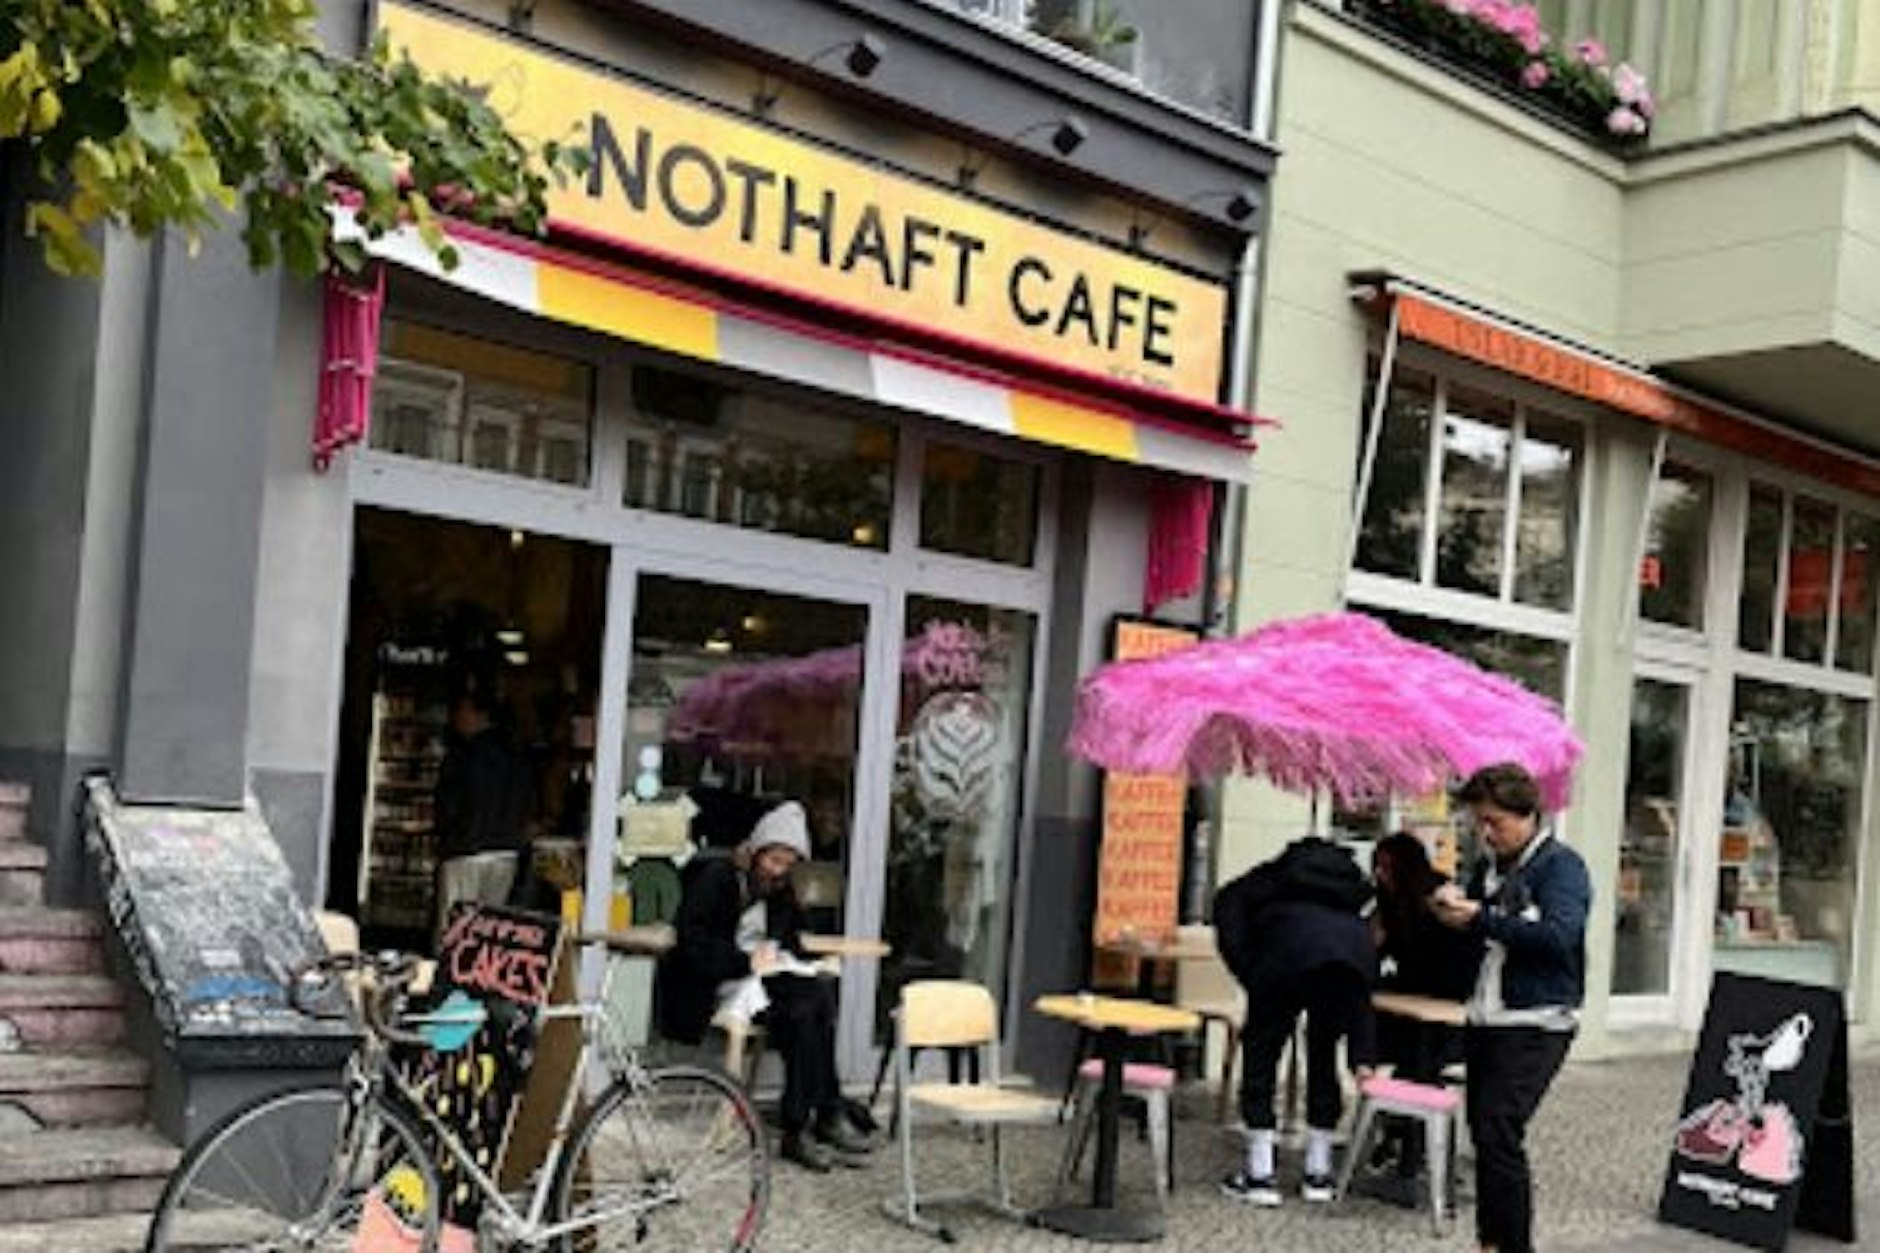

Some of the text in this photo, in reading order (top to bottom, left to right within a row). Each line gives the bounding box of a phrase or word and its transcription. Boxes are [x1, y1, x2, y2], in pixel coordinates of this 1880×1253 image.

[586, 111, 1178, 367] NOTHAFT CAFE
[450, 940, 549, 1000] CAKES
